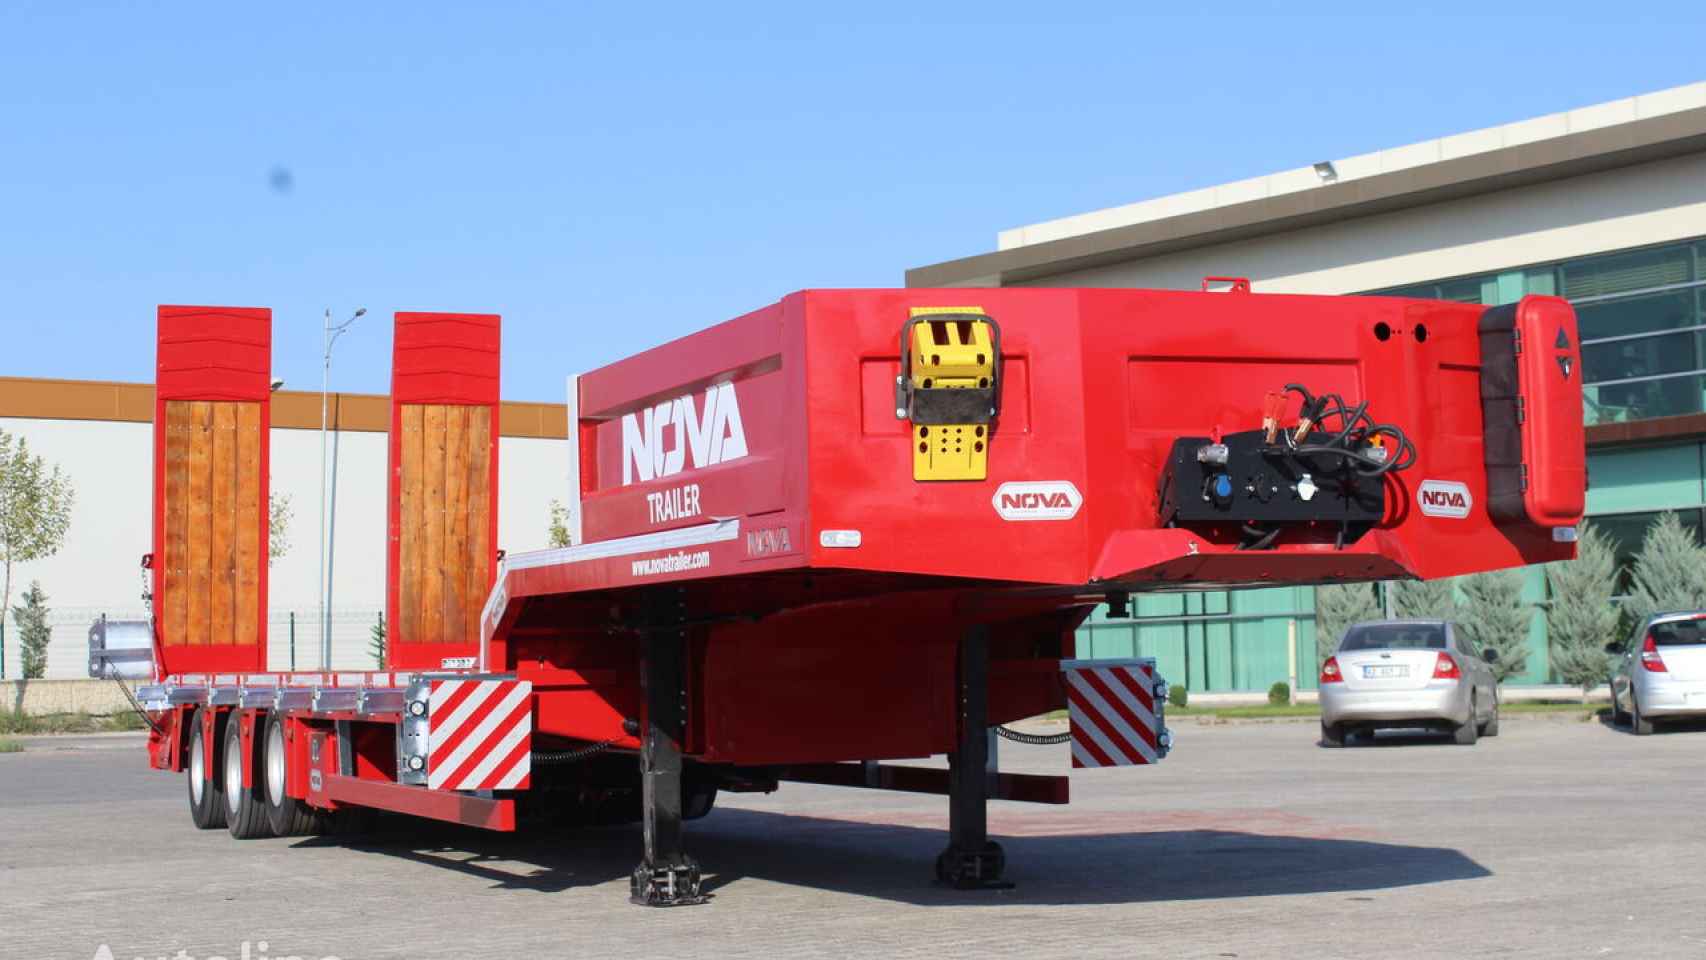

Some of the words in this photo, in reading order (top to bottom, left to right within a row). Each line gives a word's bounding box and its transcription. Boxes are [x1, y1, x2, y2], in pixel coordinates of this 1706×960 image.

[622, 380, 748, 486] NOVA
[647, 484, 701, 524] TRAILER
[1001, 493, 1072, 508] NOVA
[1423, 490, 1466, 507] NOVA
[747, 527, 791, 556] NOVA
[632, 551, 710, 576] www.novatrailer.com
